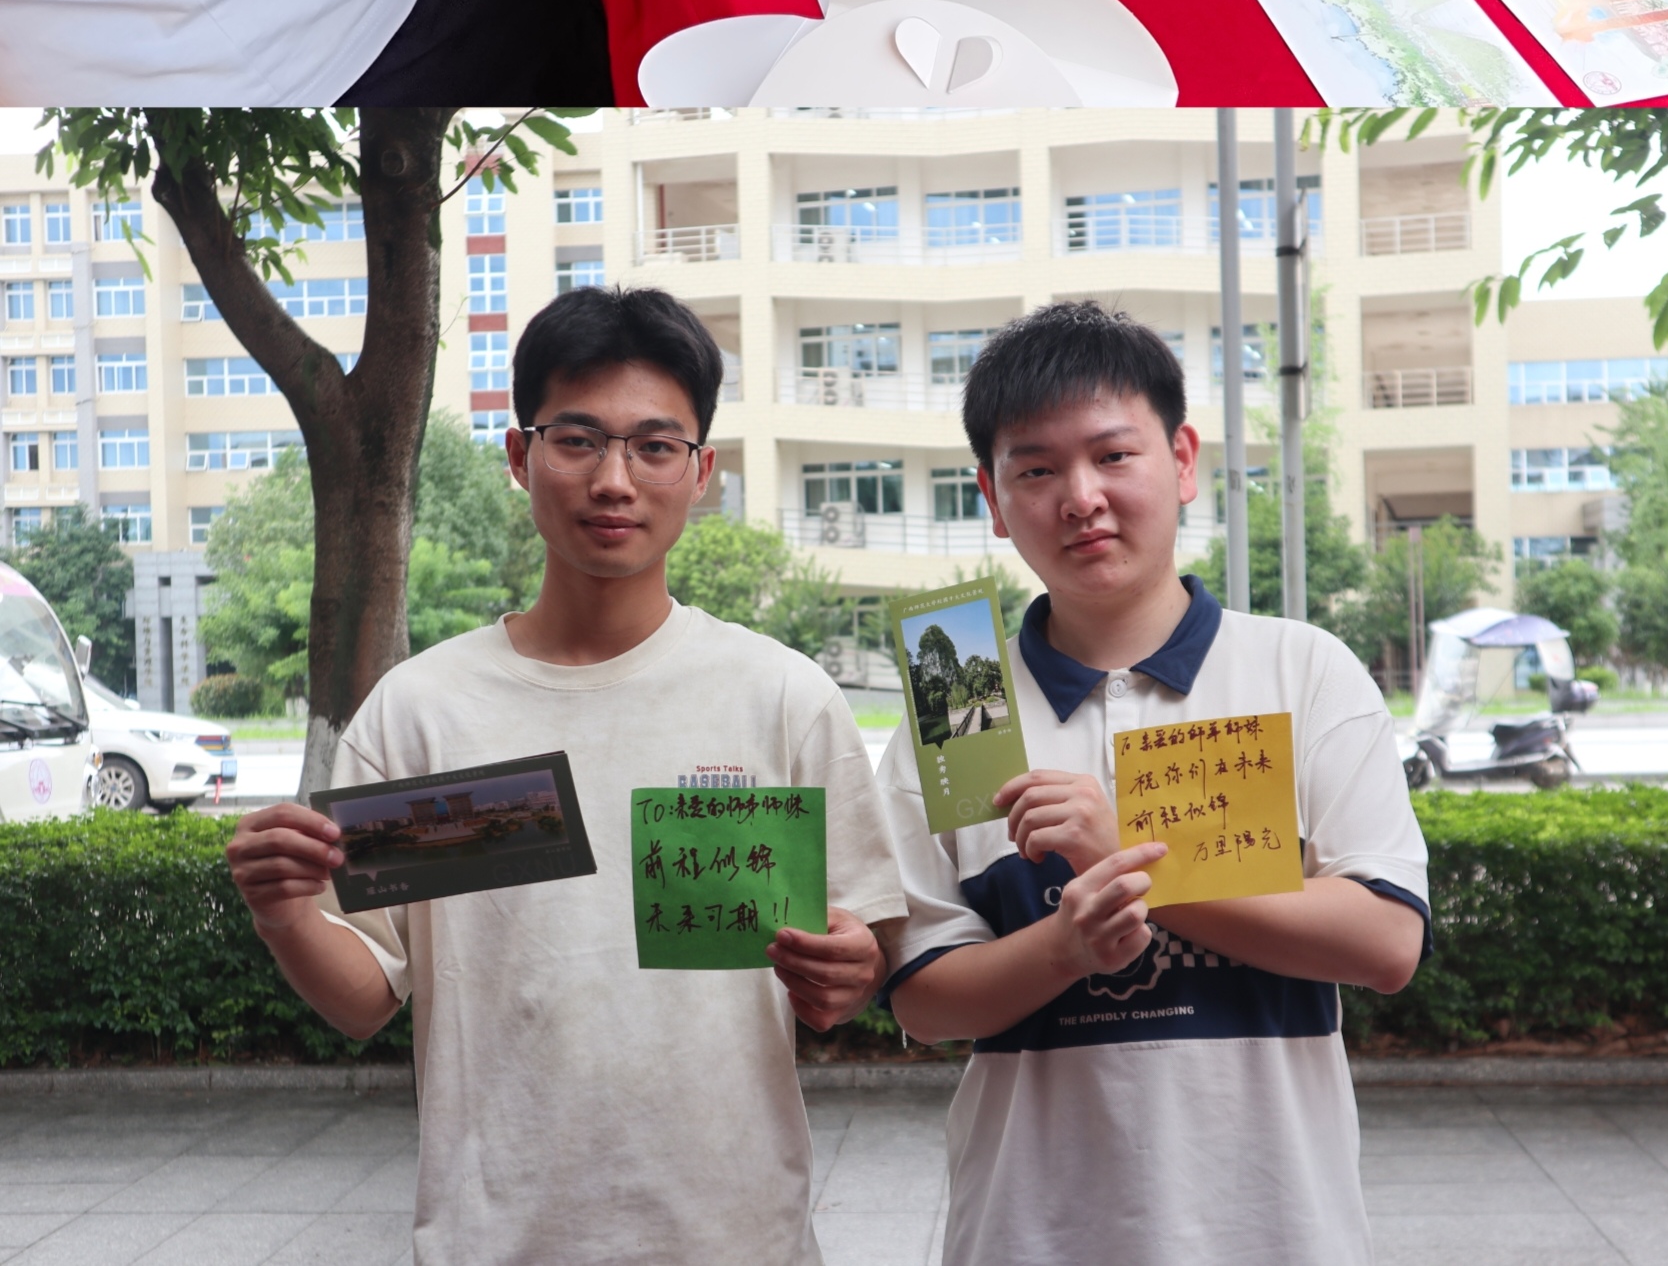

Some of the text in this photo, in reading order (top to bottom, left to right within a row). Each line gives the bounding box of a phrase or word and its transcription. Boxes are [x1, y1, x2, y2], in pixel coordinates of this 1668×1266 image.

[677, 774, 757, 788] BASEBALL
[696, 765, 744, 773] Sports Talks
[1127, 792, 1229, 842] 前程似锦
[492, 855, 577, 884] GXNU
[639, 839, 777, 889] 前程似锦
[1058, 1005, 1195, 1026] THE RAPIDLY CHANGING
